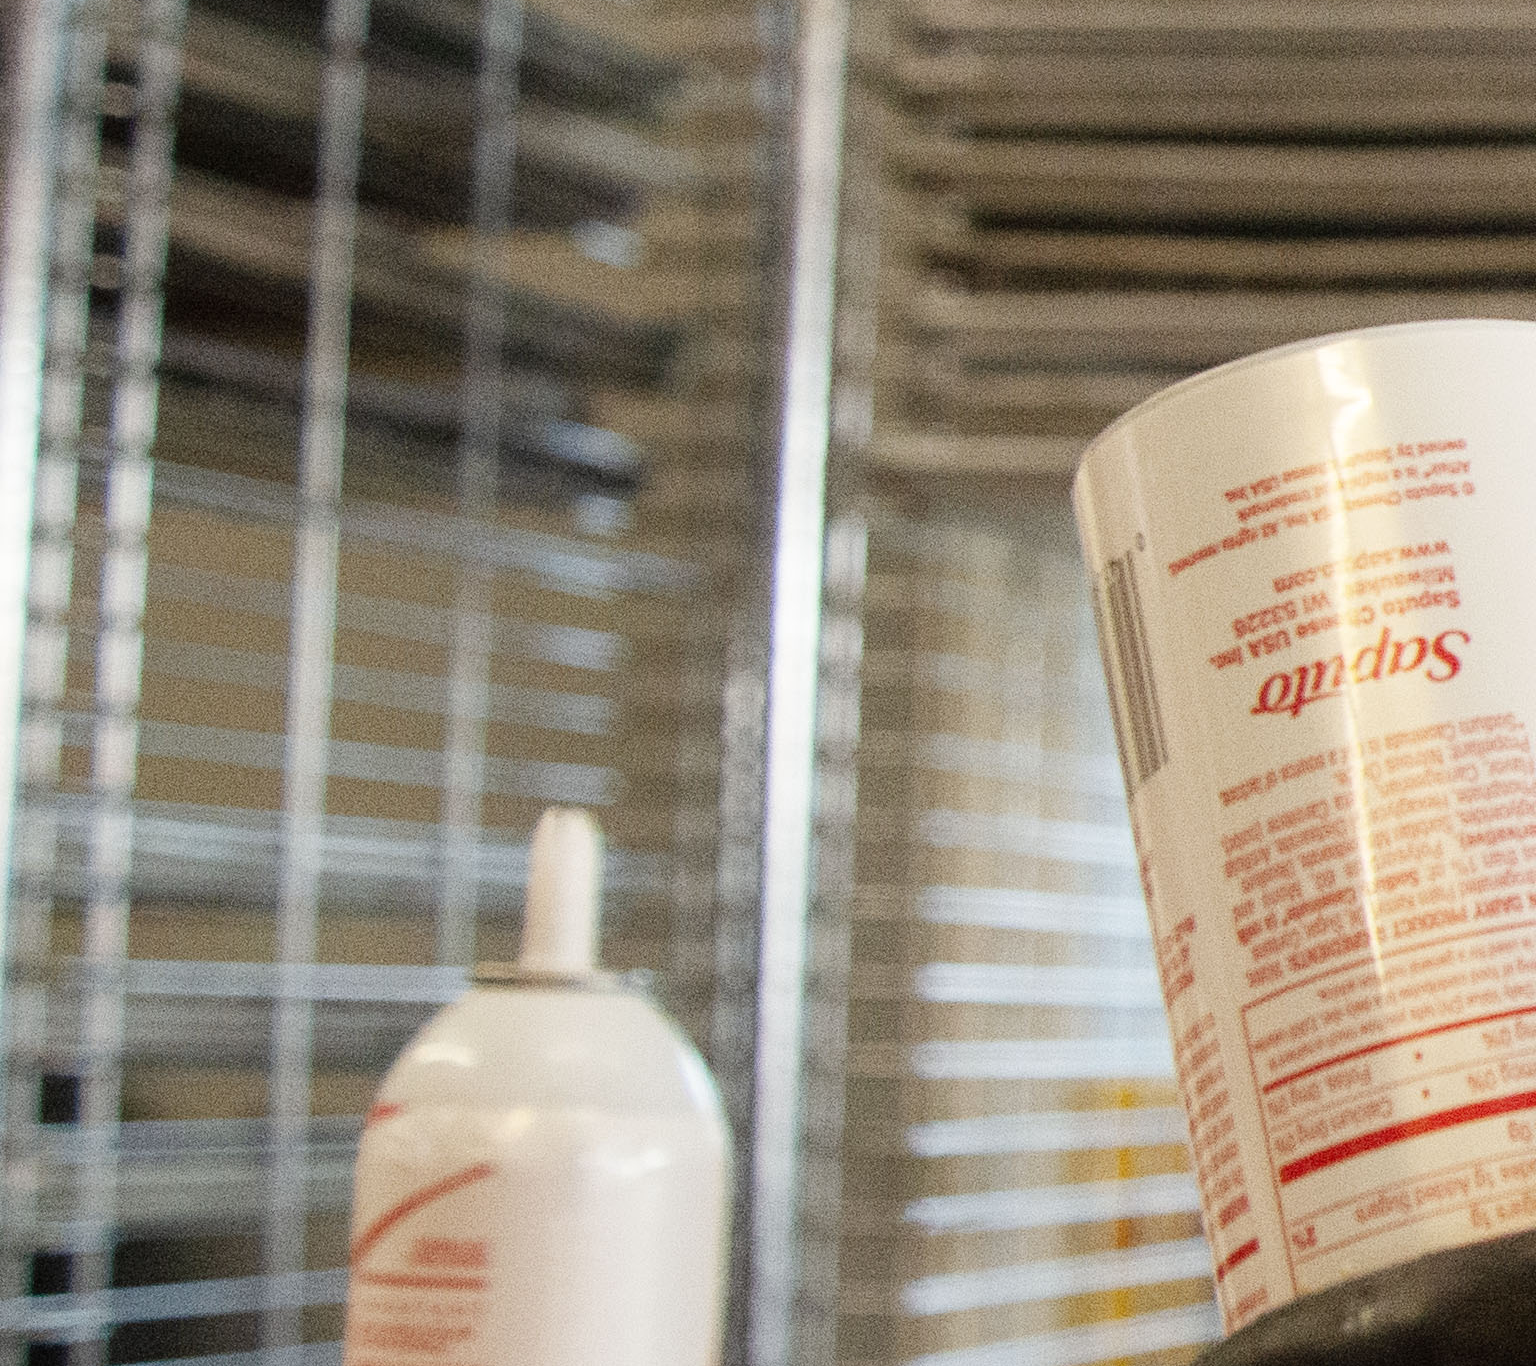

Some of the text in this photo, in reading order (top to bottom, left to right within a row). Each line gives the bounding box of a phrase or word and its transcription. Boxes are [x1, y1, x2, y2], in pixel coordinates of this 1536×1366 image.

[1340, 446, 1392, 468] Saput
[1404, 482, 1458, 501] Saputo
[1311, 505, 1332, 524] SA
[1272, 539, 1450, 594] www.sapuo.com
[1302, 590, 1329, 612] WI
[1382, 588, 1460, 616] Saputo
[1231, 599, 1296, 638] 53226
[1247, 629, 1290, 659] USA
[1208, 646, 1242, 670] Inc.
[1244, 625, 1476, 718] Saputo
[1372, 868, 1419, 892] Sodiu
[1373, 895, 1414, 916] Kerne
[1474, 894, 1521, 919] DAIRY
[1393, 907, 1466, 939] PRODUCT
[1329, 1098, 1394, 1134] Calcium
[1506, 1119, 1532, 1144] 0g
[1414, 1177, 1469, 1206] Added
[1352, 1190, 1411, 1224] Sugars
